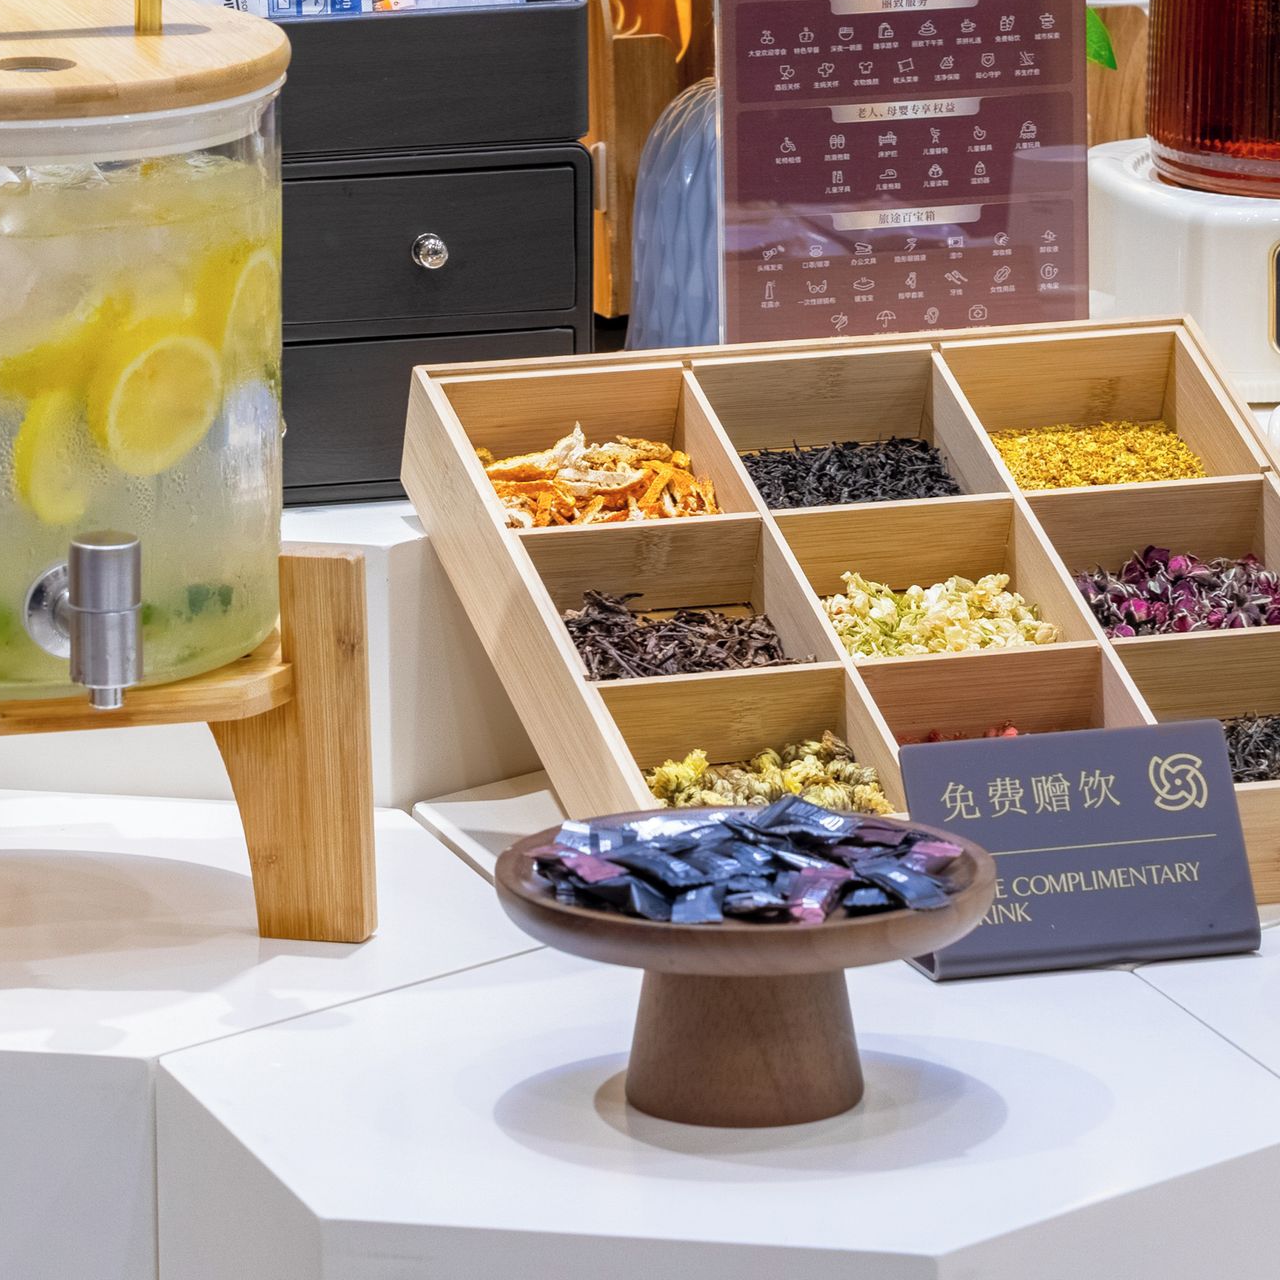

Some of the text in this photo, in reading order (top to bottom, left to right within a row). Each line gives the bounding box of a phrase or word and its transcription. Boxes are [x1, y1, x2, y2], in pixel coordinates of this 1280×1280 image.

[857, 101, 956, 119] 老人、母婴专享权益
[878, 210, 935, 225] 旅途百宝箱
[940, 769, 1120, 822] 免费赠饮
[1012, 861, 1201, 899] COMPLIMENTARY
